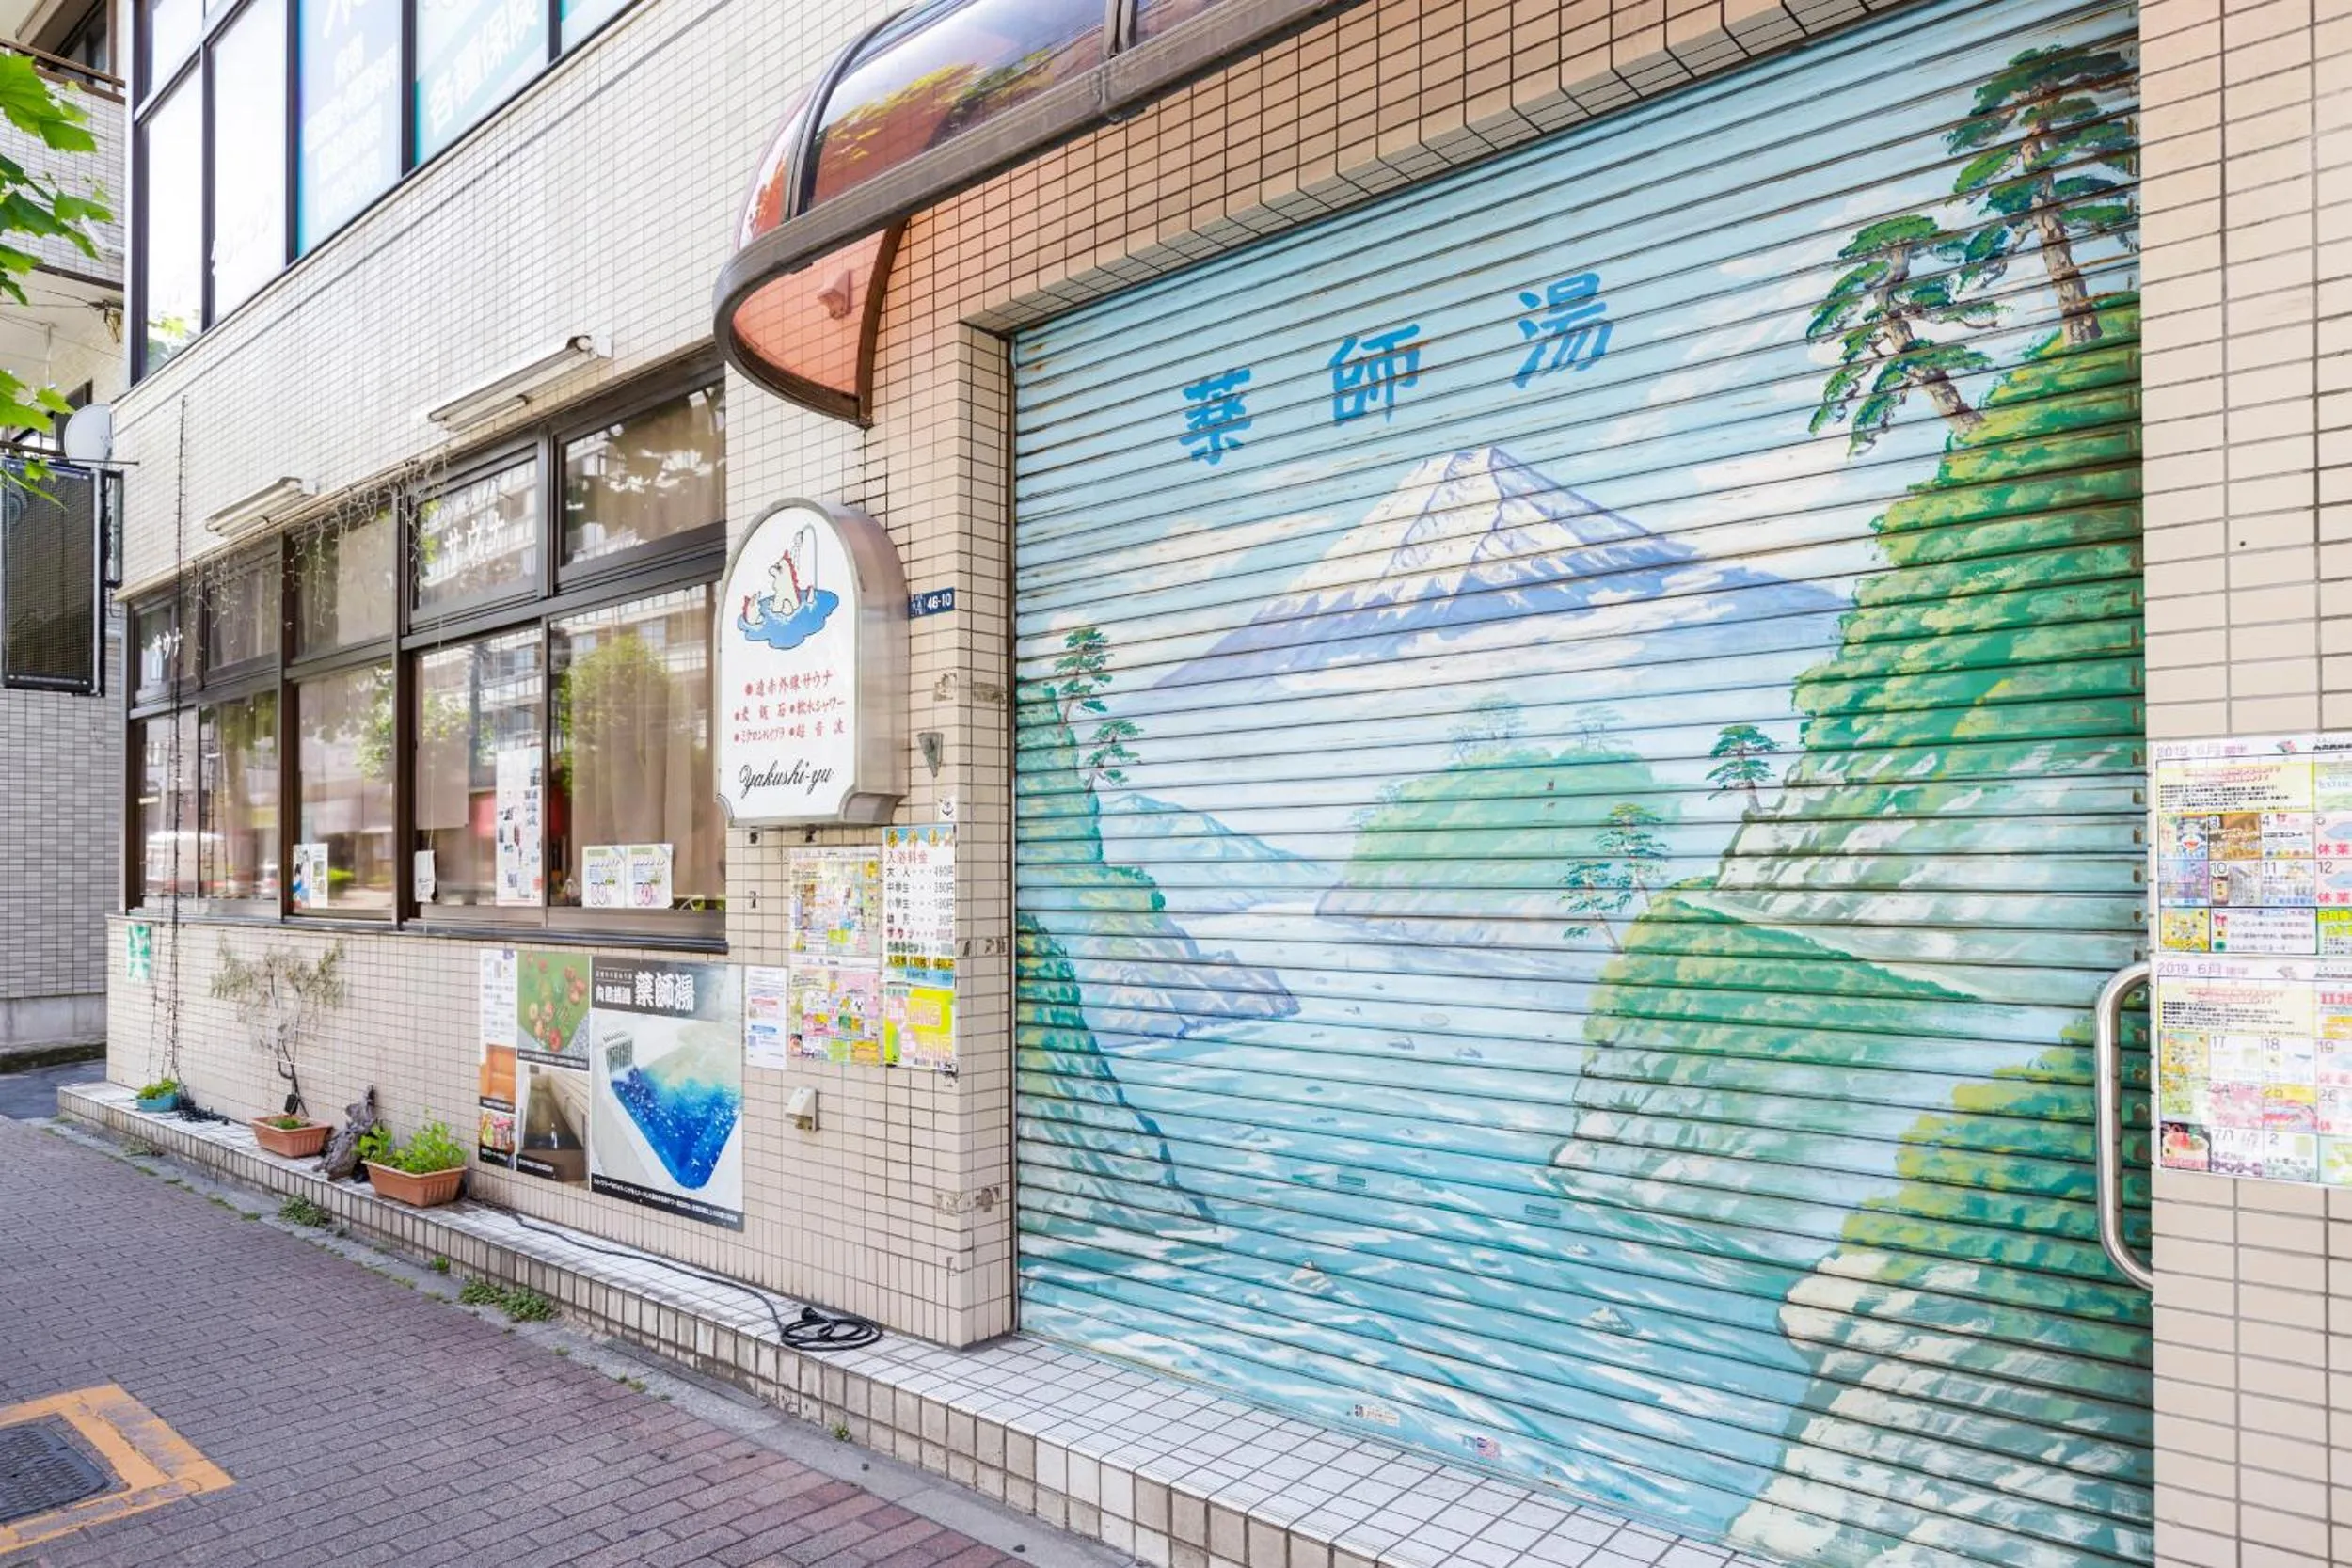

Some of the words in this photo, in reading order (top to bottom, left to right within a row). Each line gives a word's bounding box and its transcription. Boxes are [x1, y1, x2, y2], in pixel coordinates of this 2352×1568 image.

[2210, 862, 2228, 874] 10
[2264, 862, 2277, 874] 11
[2317, 861, 2333, 874] 12
[2157, 961, 2189, 974] 2019
[2213, 1036, 2226, 1048] 17
[2265, 1038, 2280, 1051] 18
[2318, 1040, 2334, 1053] 19
